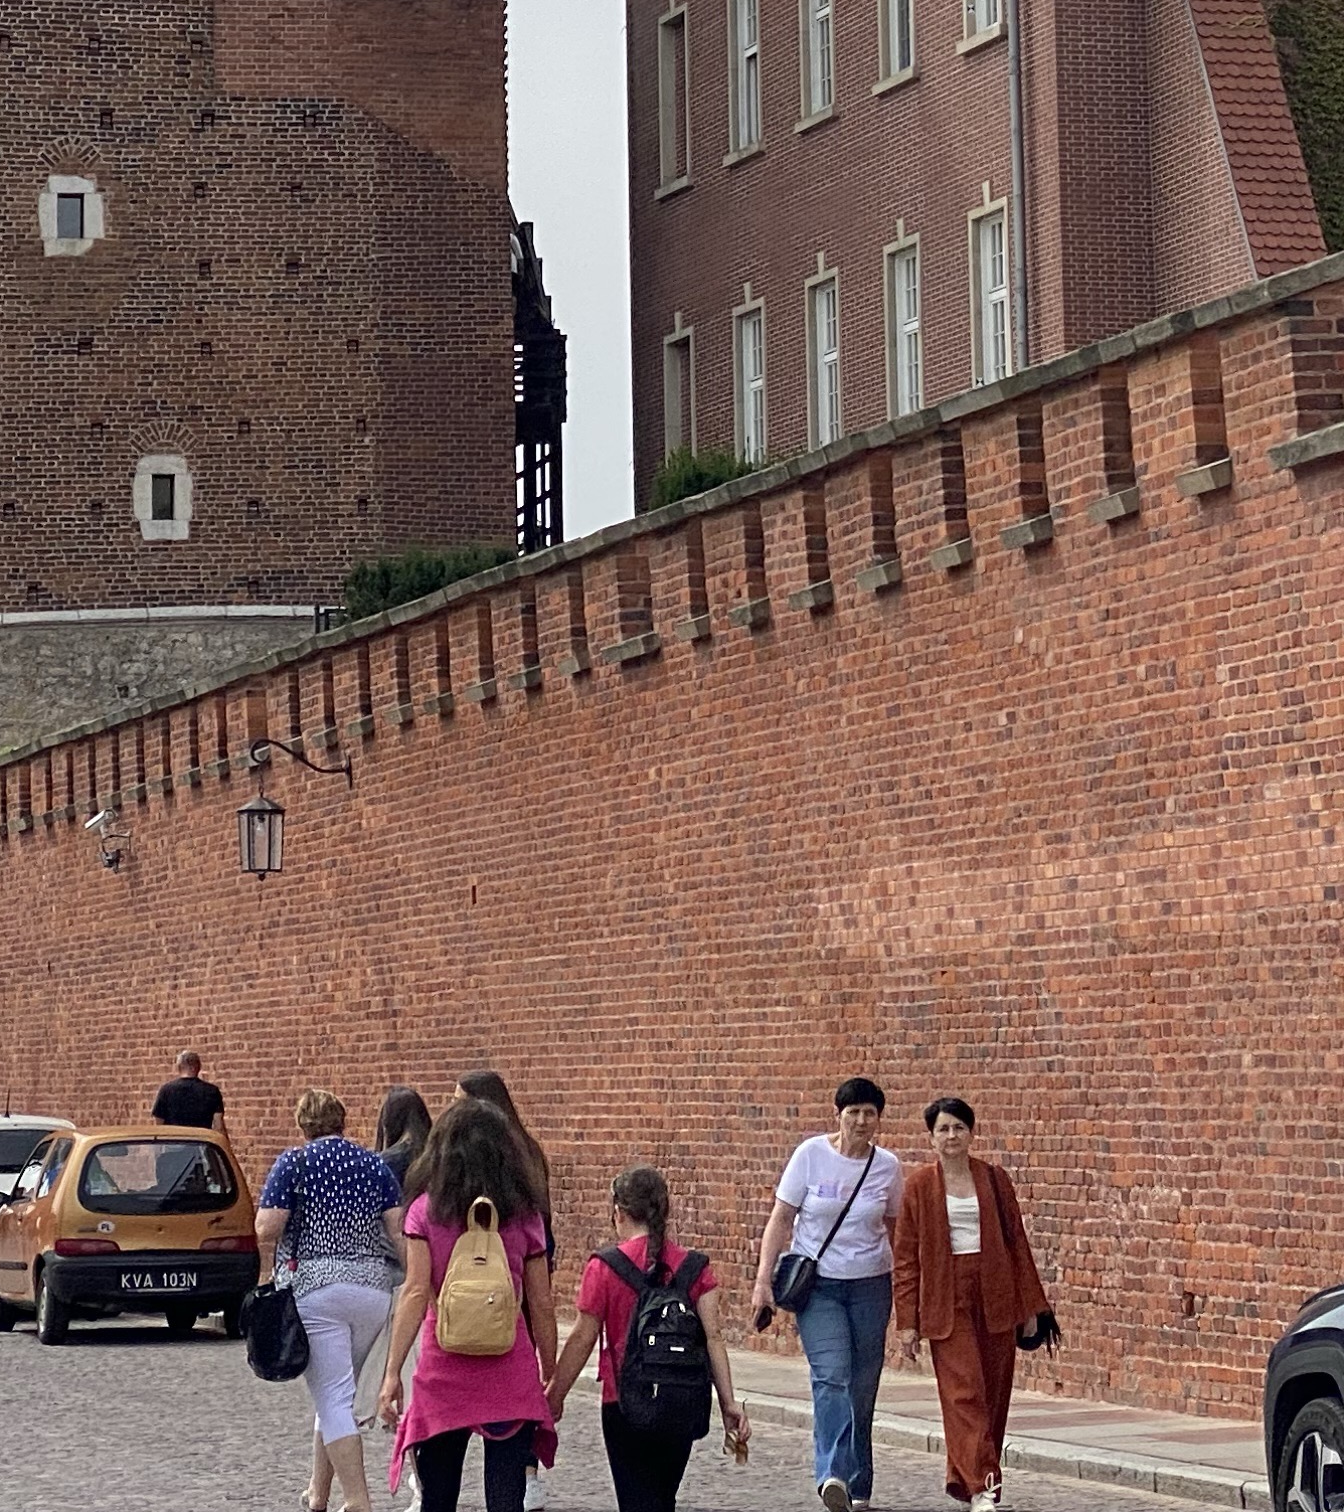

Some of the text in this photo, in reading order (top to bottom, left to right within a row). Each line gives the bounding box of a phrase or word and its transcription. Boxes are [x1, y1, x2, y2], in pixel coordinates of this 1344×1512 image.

[101, 1223, 112, 1232] PL
[121, 1272, 197, 1288] KVA 103N
